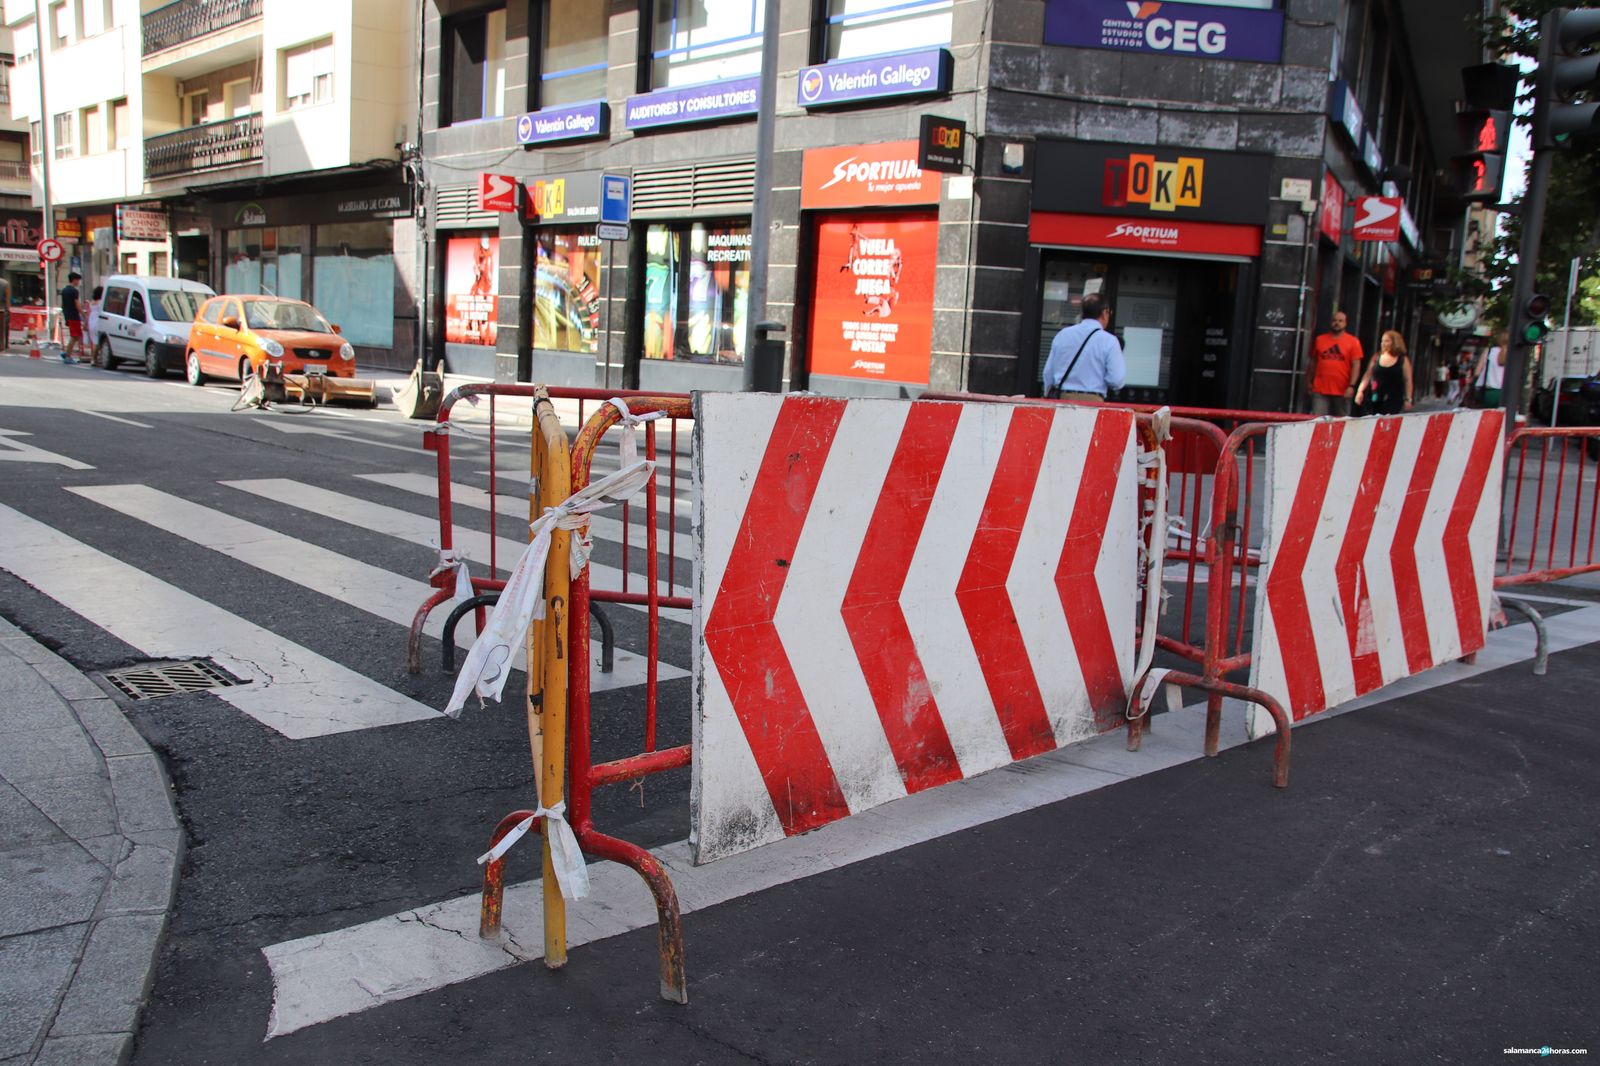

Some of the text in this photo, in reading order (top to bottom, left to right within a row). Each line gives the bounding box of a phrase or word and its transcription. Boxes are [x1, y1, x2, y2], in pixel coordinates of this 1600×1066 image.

[1102, 19, 1132, 29] CENTRO
[1102, 28, 1143, 38] ESTUDIOS
[1145, 17, 1226, 54] CEG
[828, 65, 931, 92] Valentín Gallego
[629, 89, 757, 120] AUDITORES Y CONSULTORES
[566, 113, 595, 131] Gallego
[933, 128, 960, 147] TOKA
[819, 156, 922, 190] SPORTIUM
[867, 182, 875, 192] Tu
[875, 183, 895, 193] mejor
[1106, 158, 1200, 208] TOKA
[1105, 222, 1179, 240] SPORTIUM
[859, 238, 895, 256] VUELA
[852, 258, 891, 276] CORRE
[855, 278, 892, 295] JUEGA
[851, 340, 887, 353] APOSTAR
